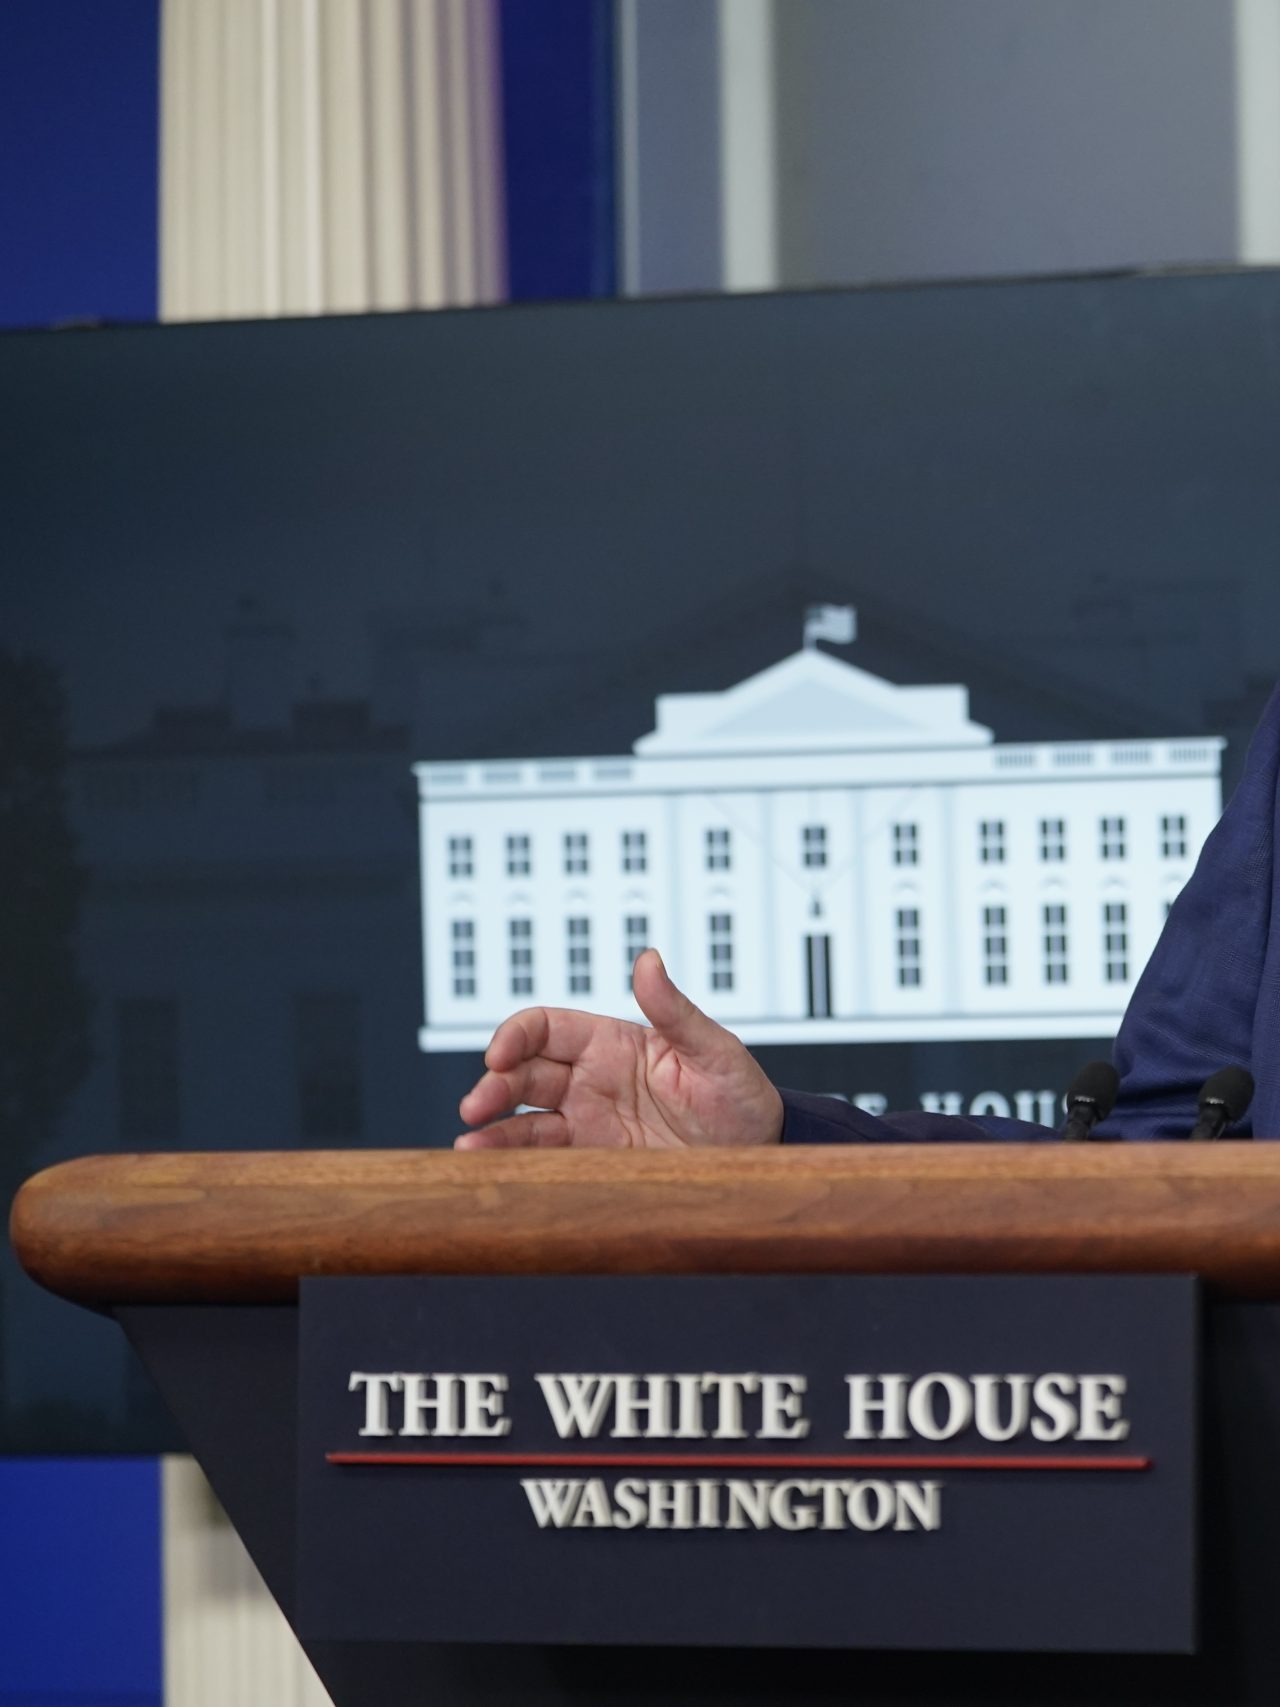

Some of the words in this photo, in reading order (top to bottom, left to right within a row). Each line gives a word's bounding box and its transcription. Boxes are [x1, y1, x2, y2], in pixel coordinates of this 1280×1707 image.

[348, 1371, 511, 1438] THE
[534, 1372, 811, 1440] WHITE
[844, 1372, 1131, 1443] HOUSE
[520, 1478, 943, 1532] WASHINGTON
